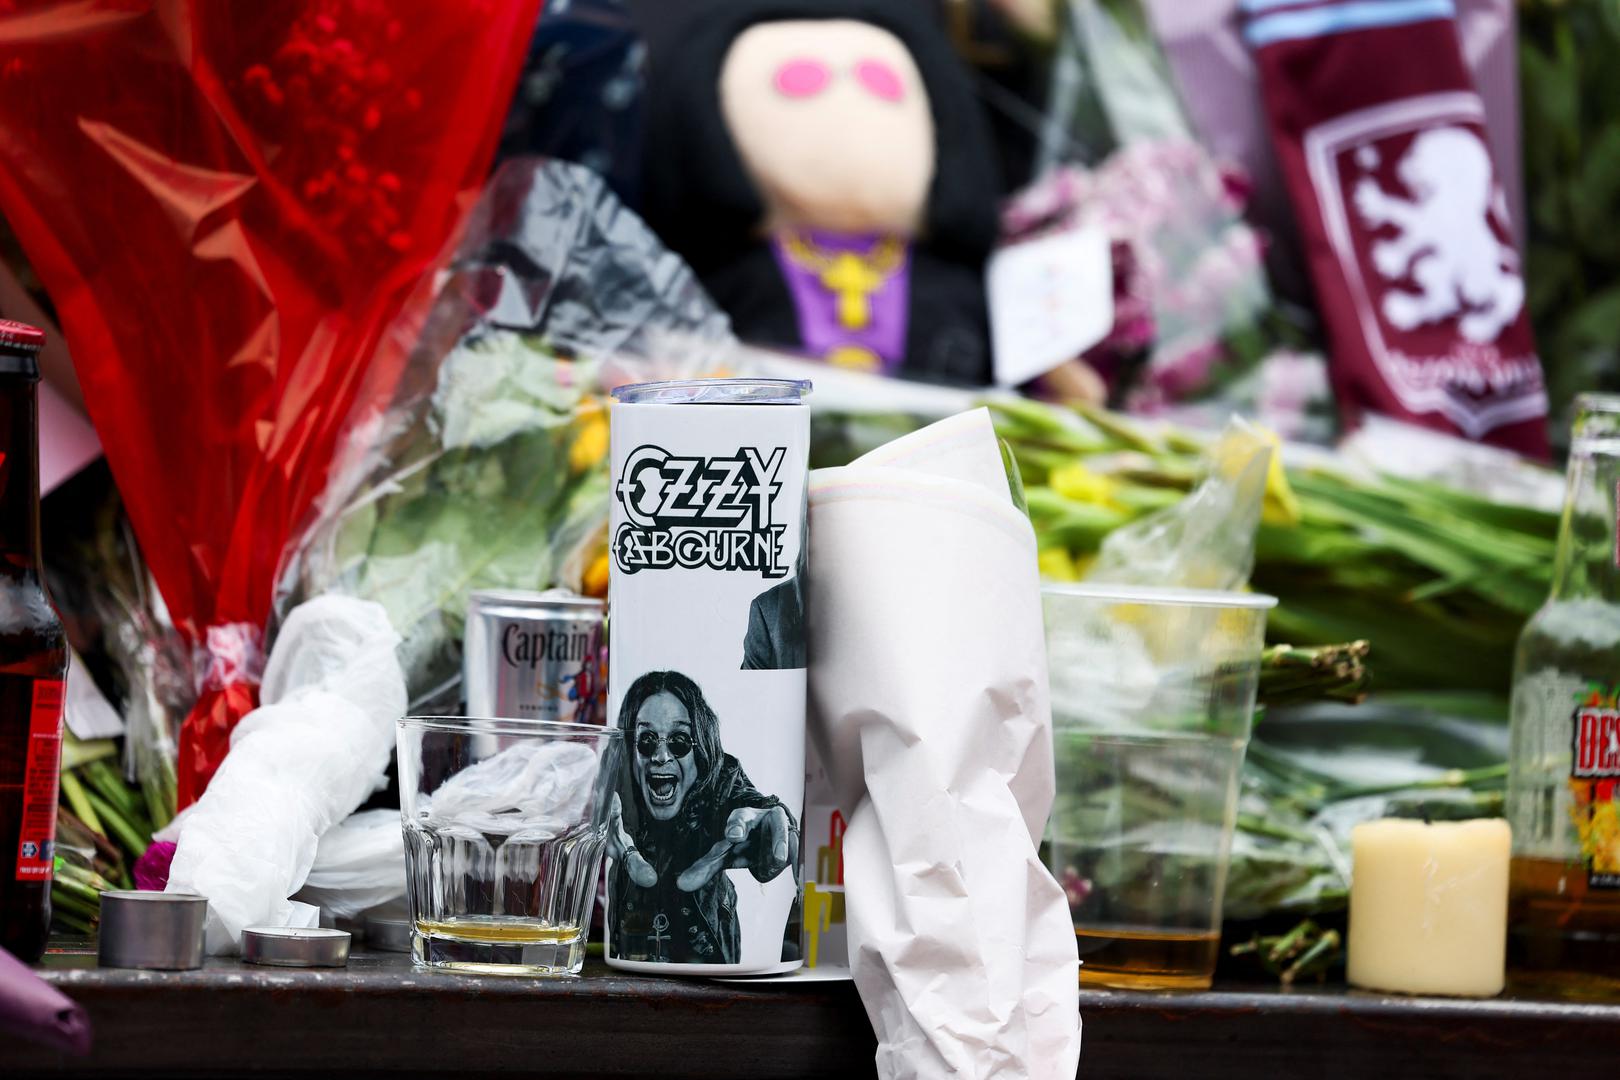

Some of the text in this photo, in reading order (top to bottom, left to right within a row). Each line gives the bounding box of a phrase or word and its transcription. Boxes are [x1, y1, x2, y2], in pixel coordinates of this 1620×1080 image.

[616, 444, 788, 531] OZZY
[612, 521, 789, 578] OSBOURNE
[502, 622, 589, 669] Captain
[1576, 712, 1620, 772] DE
